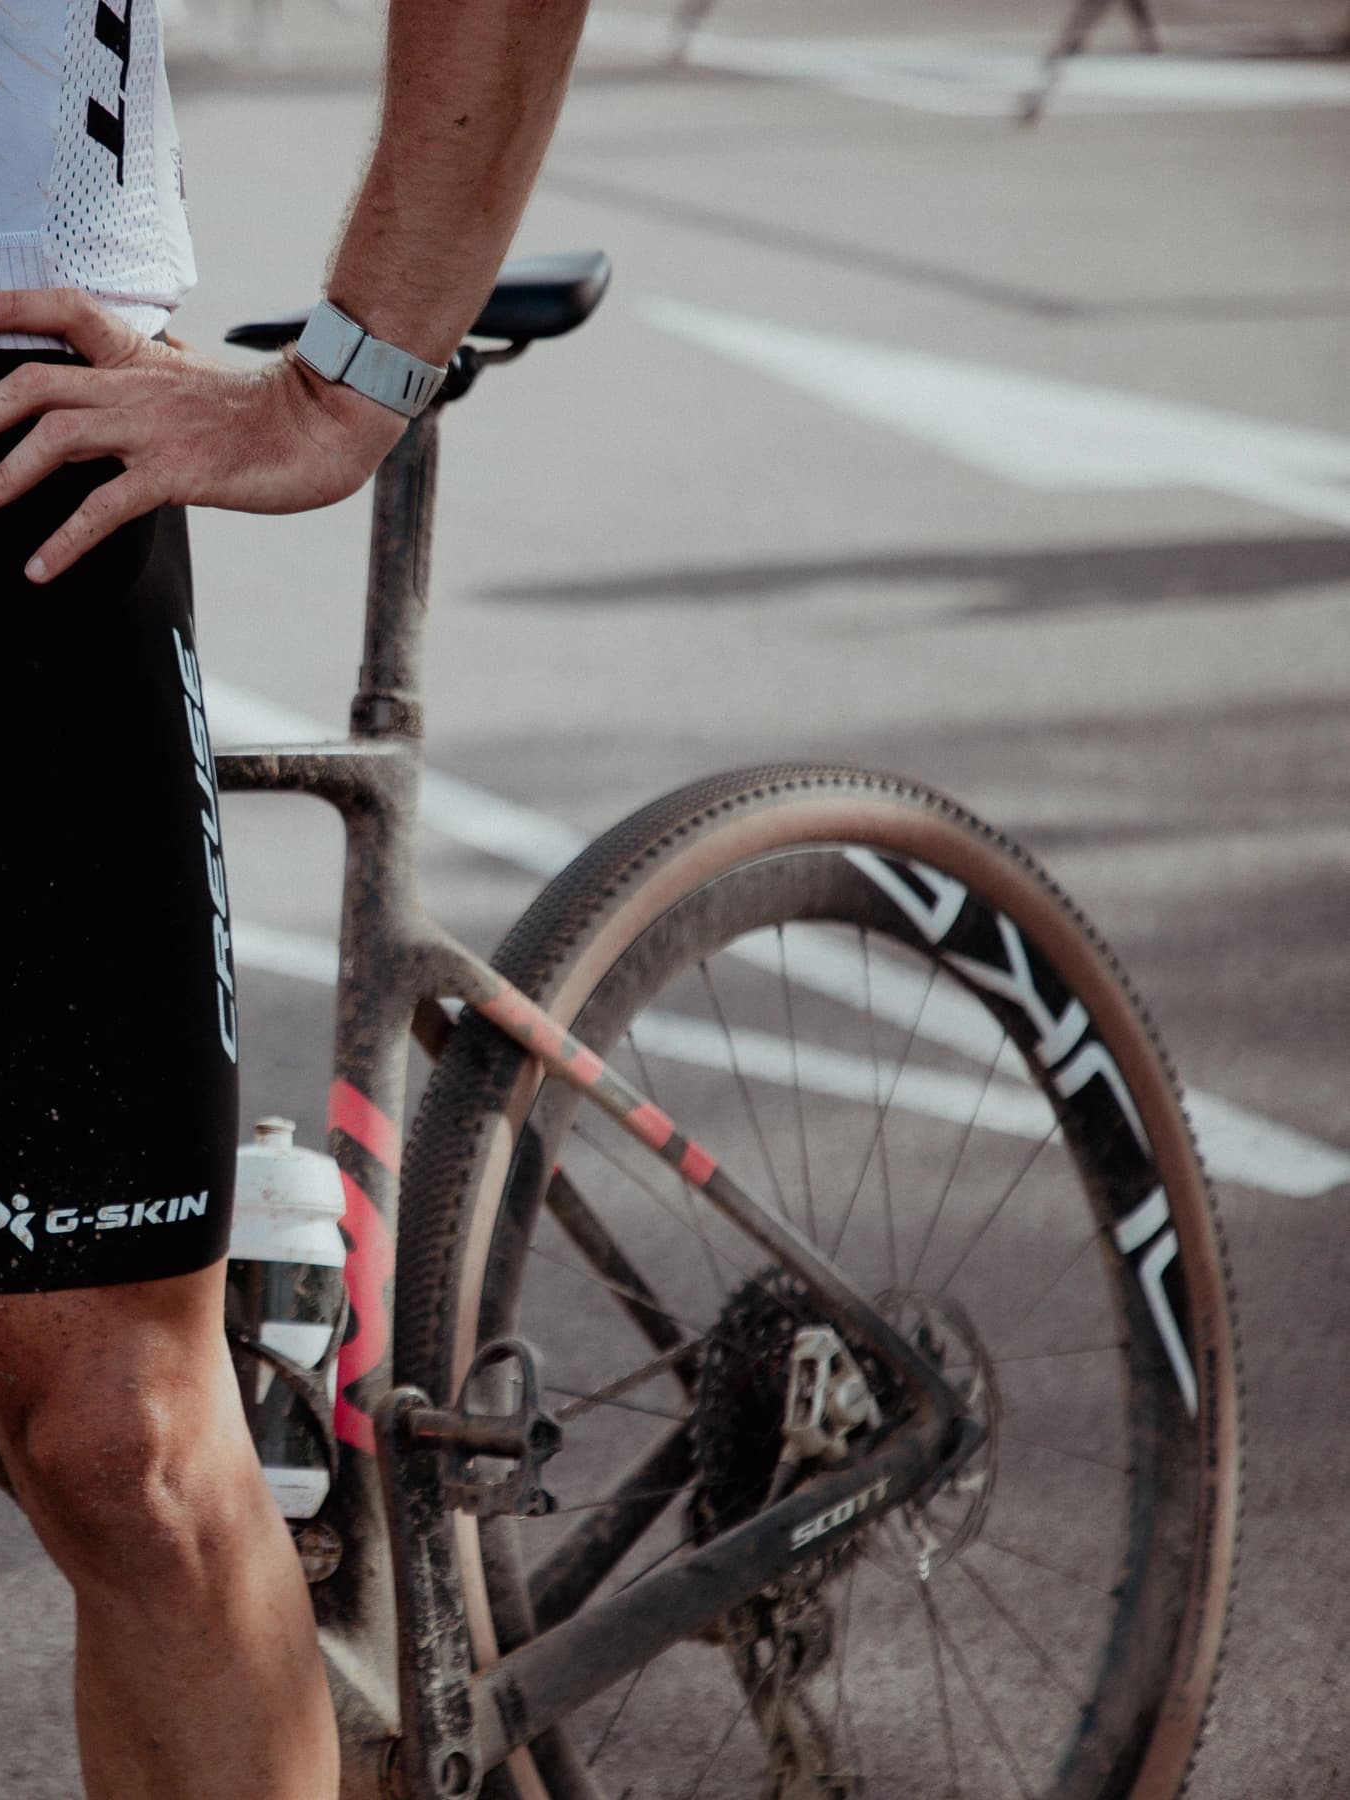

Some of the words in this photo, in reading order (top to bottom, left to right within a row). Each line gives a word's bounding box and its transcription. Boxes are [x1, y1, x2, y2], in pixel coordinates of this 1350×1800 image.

[174, 627, 238, 1065] CREUSE
[45, 1190, 209, 1234] G-SKIN
[790, 1475, 893, 1552] SCOTT
